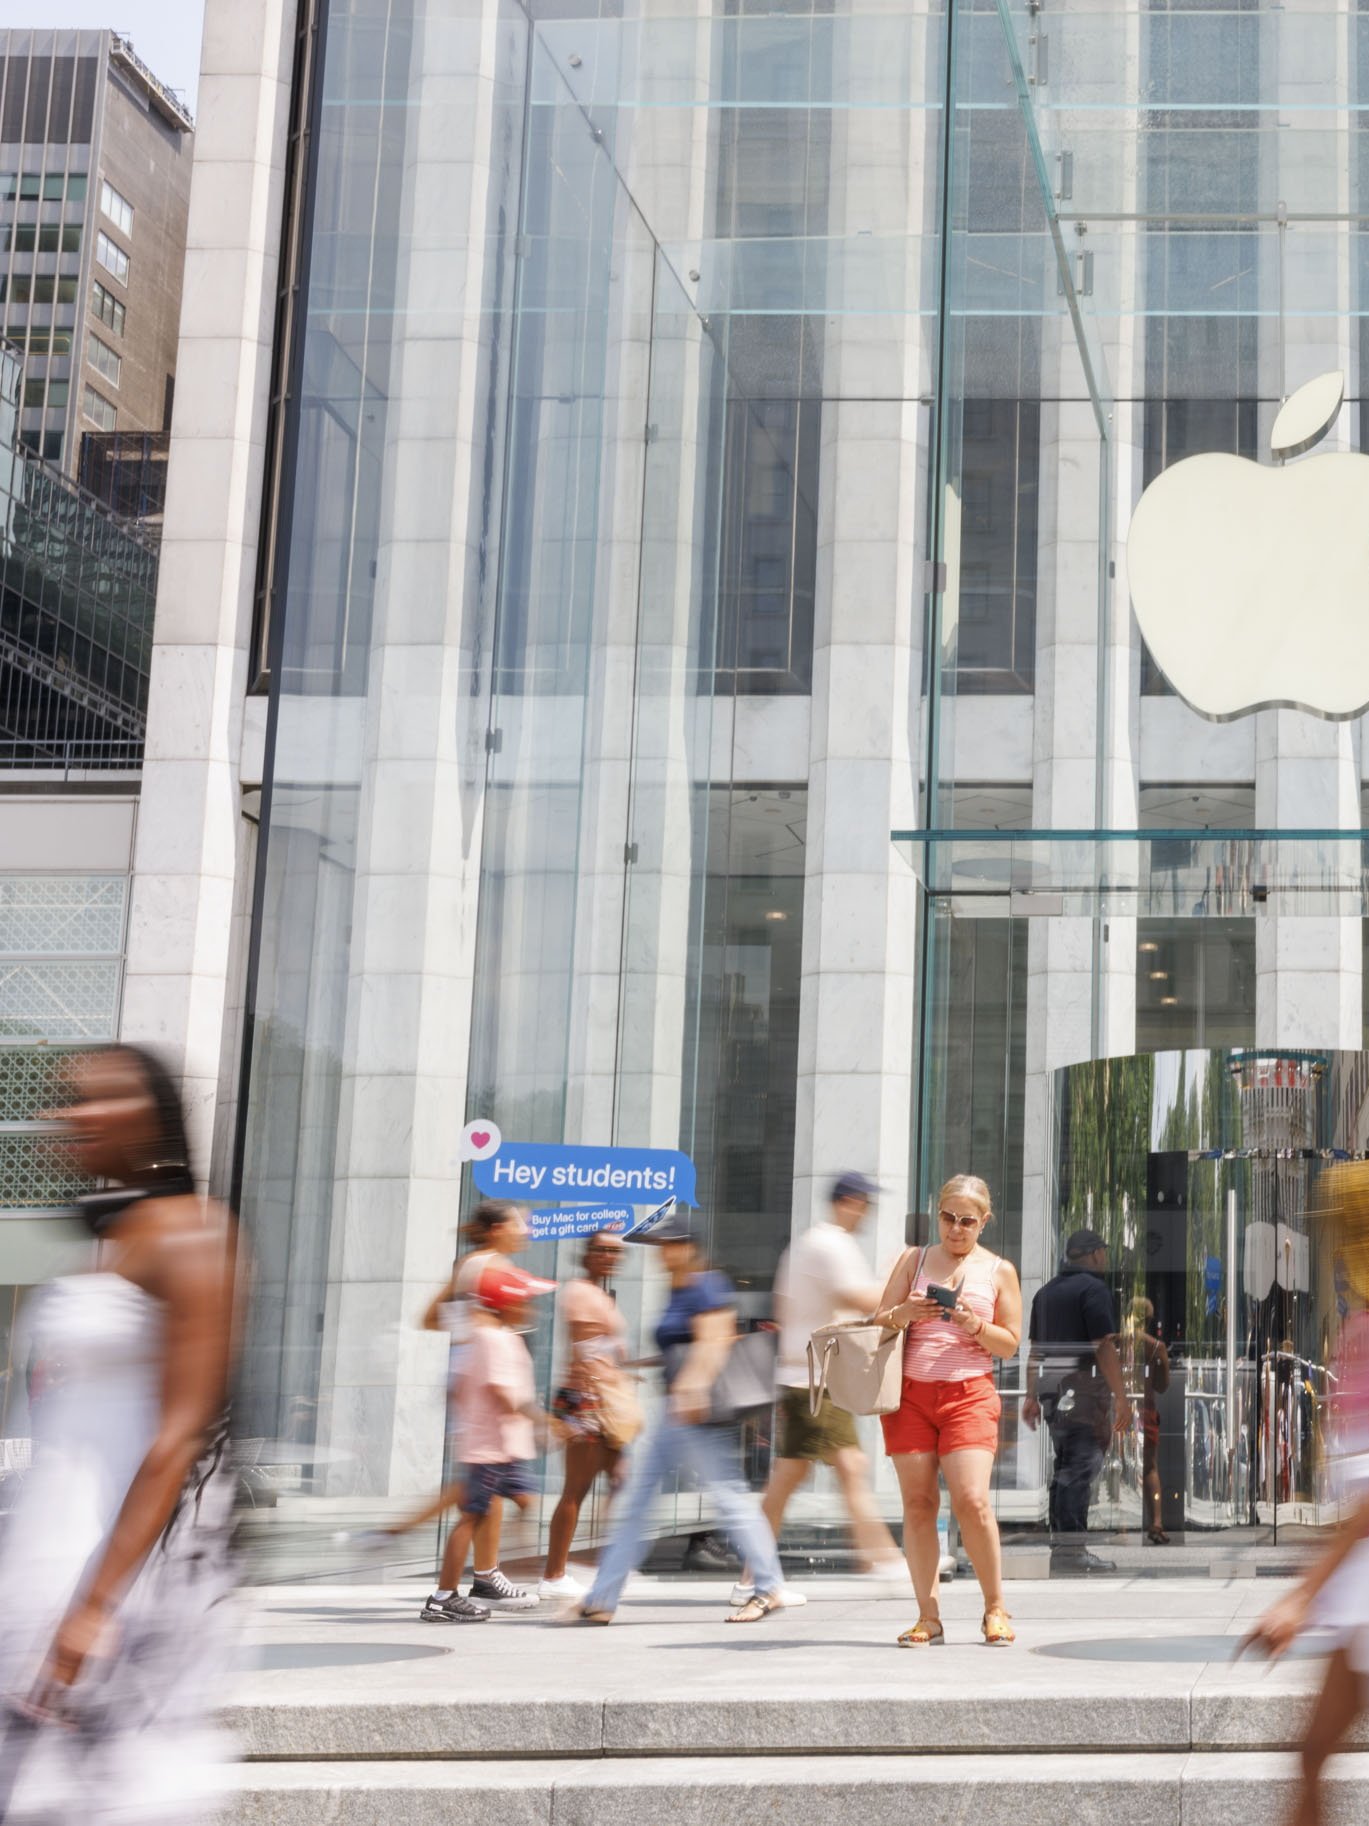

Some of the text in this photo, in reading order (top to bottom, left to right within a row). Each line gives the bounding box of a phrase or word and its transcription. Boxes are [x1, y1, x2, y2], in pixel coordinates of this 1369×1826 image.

[493, 1158, 676, 1190] Hey students!
[532, 1209, 629, 1225] Buy Mac for college,
[532, 1228, 549, 1238] get
[558, 1225, 575, 1236] gift
[577, 1222, 599, 1232] card
